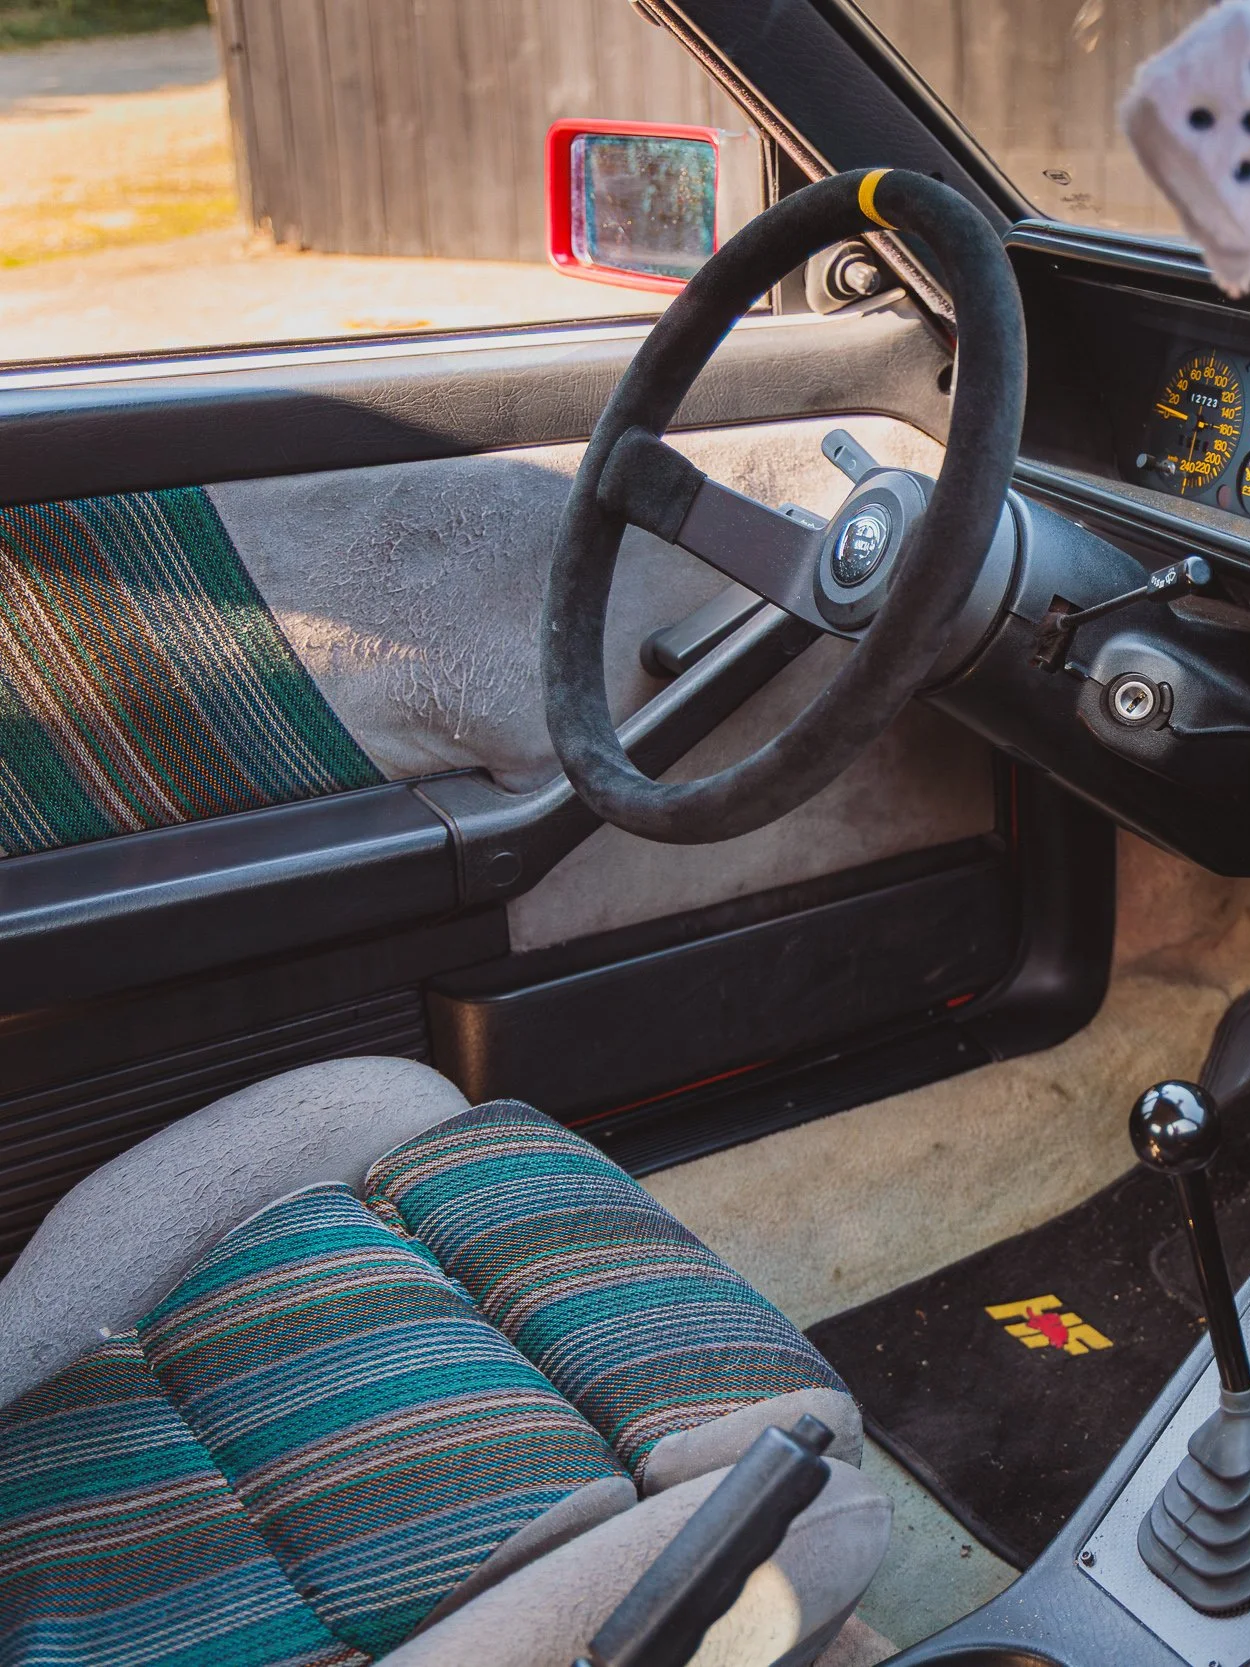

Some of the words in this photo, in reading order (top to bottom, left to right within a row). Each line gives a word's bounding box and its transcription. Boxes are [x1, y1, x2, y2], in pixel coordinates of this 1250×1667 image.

[1190, 369, 1202, 381] 60
[1203, 366, 1215, 378] 80
[1177, 380, 1188, 391] 40
[1214, 375, 1229, 388] 100
[1169, 394, 1180, 405] 20
[1191, 394, 1218, 408] 12723
[1221, 391, 1235, 403] 120
[1221, 407, 1235, 419] 140
[1219, 423, 1234, 436] 160
[1214, 439, 1228, 452] 180
[1205, 452, 1221, 465] 200
[1180, 460, 1196, 473] 240
[1195, 462, 1211, 475] 220
